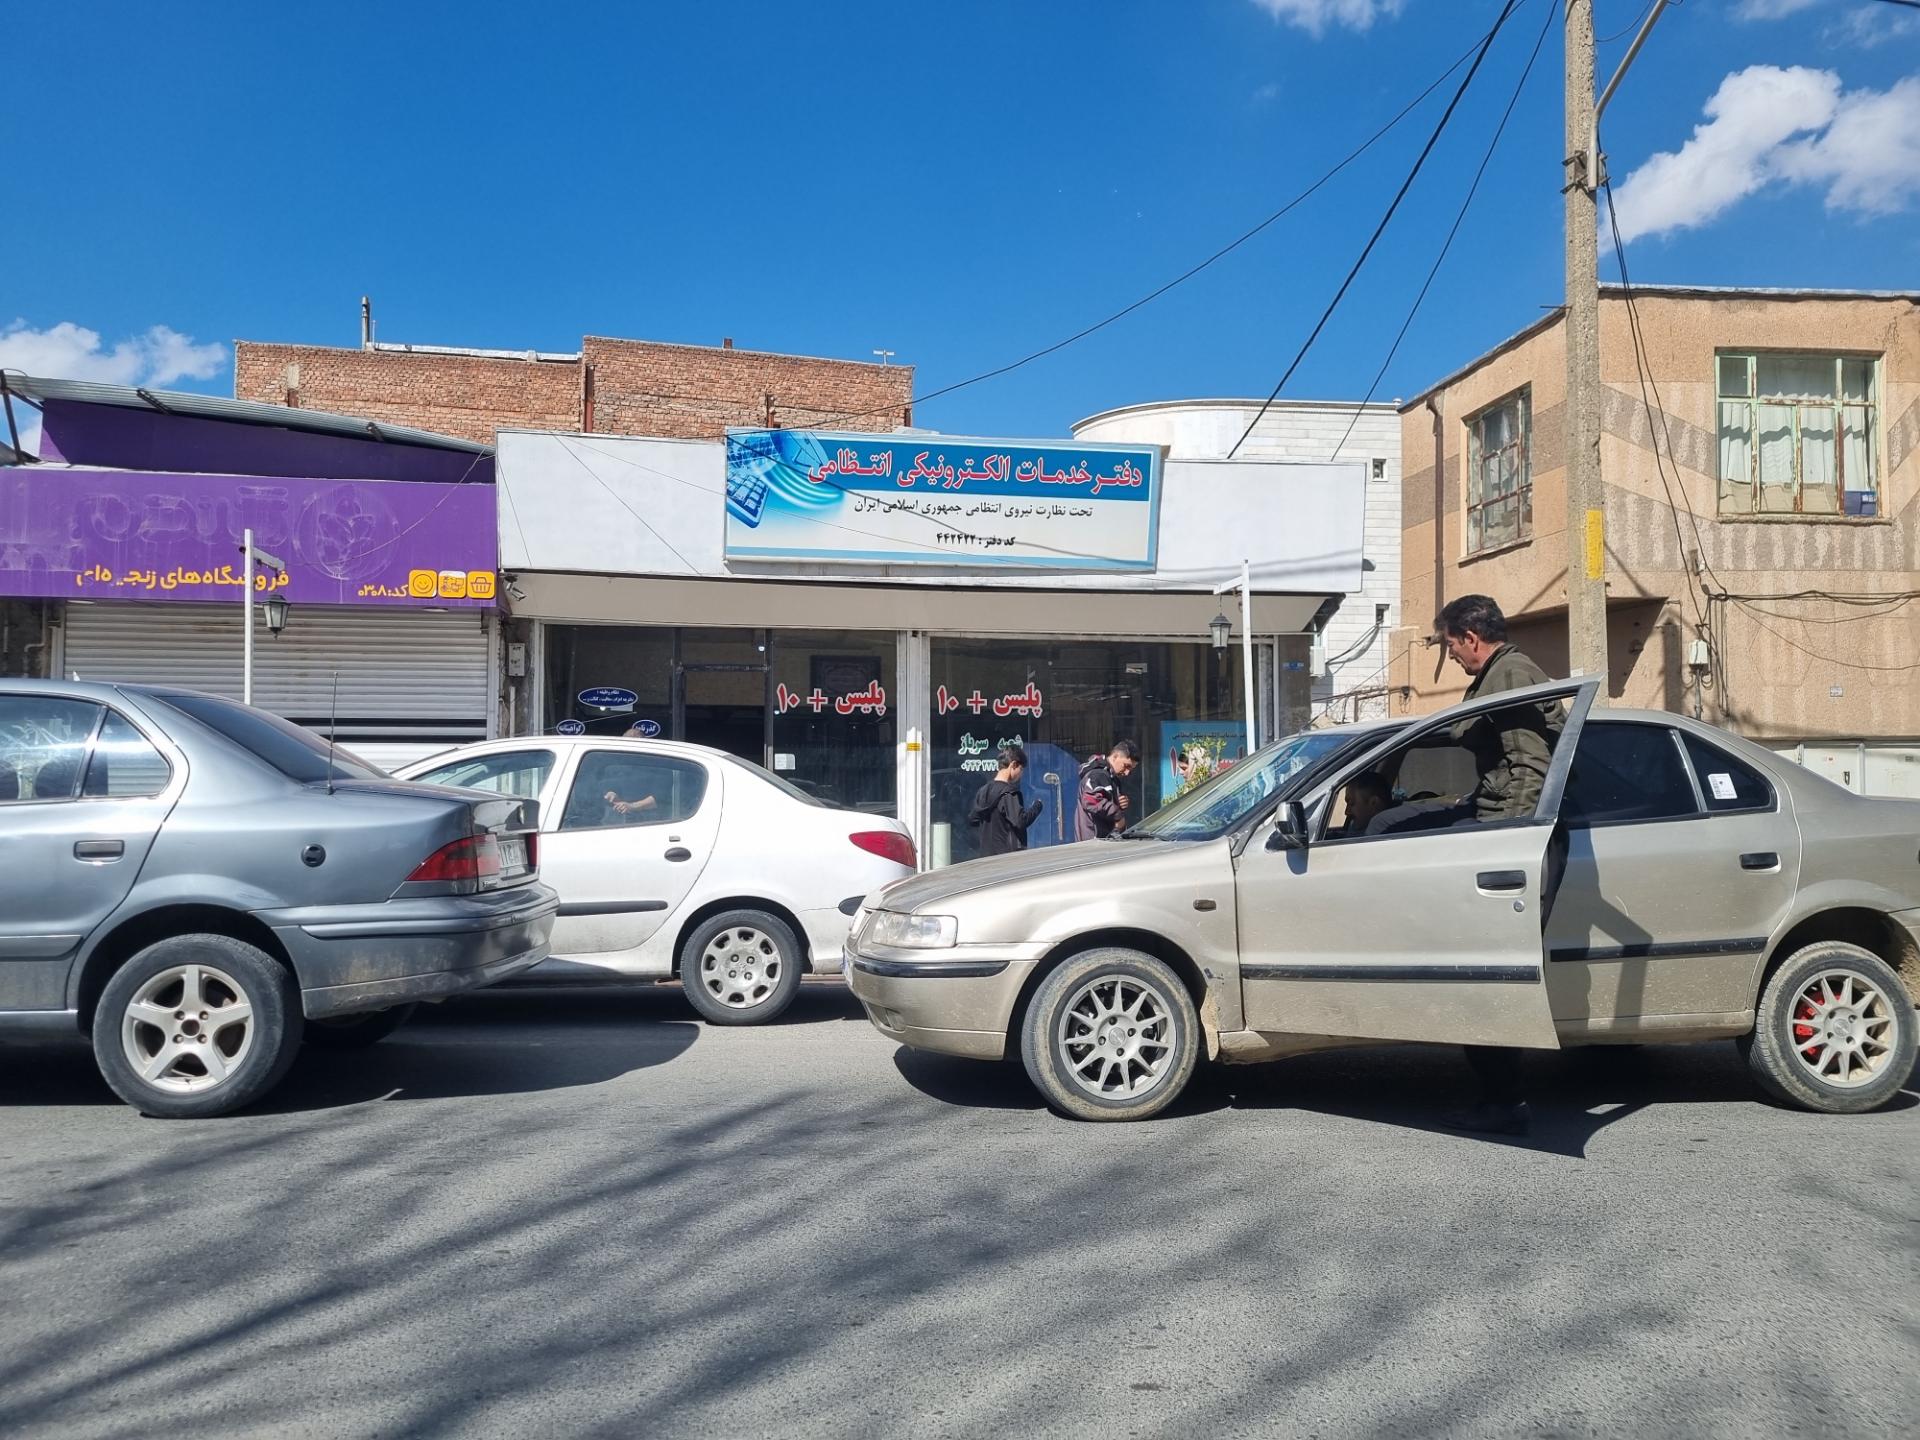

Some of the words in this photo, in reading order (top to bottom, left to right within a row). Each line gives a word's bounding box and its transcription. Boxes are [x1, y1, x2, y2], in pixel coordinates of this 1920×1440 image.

[808, 448, 892, 484] انتظامی
[896, 451, 1011, 488] الکترونیکی
[1016, 457, 1093, 484] خدمات
[1090, 459, 1143, 495] دفتر
[854, 496, 880, 512] ایران
[882, 499, 919, 513] اسلامی
[921, 503, 962, 515] جمهوری
[965, 502, 1001, 516] انتظامی
[1004, 504, 1033, 518] نیروی
[1036, 504, 1066, 519] نظارت
[1069, 507, 1093, 517] تحت
[1004, 536, 1016, 546] کد
[777, 683, 800, 713] ۱۰
[807, 688, 828, 712] +
[835, 680, 886, 716] پلیس
[937, 685, 959, 715] ۱۰
[966, 690, 987, 714] +
[993, 682, 1043, 718] پلیس
[958, 732, 989, 755] سرباز
